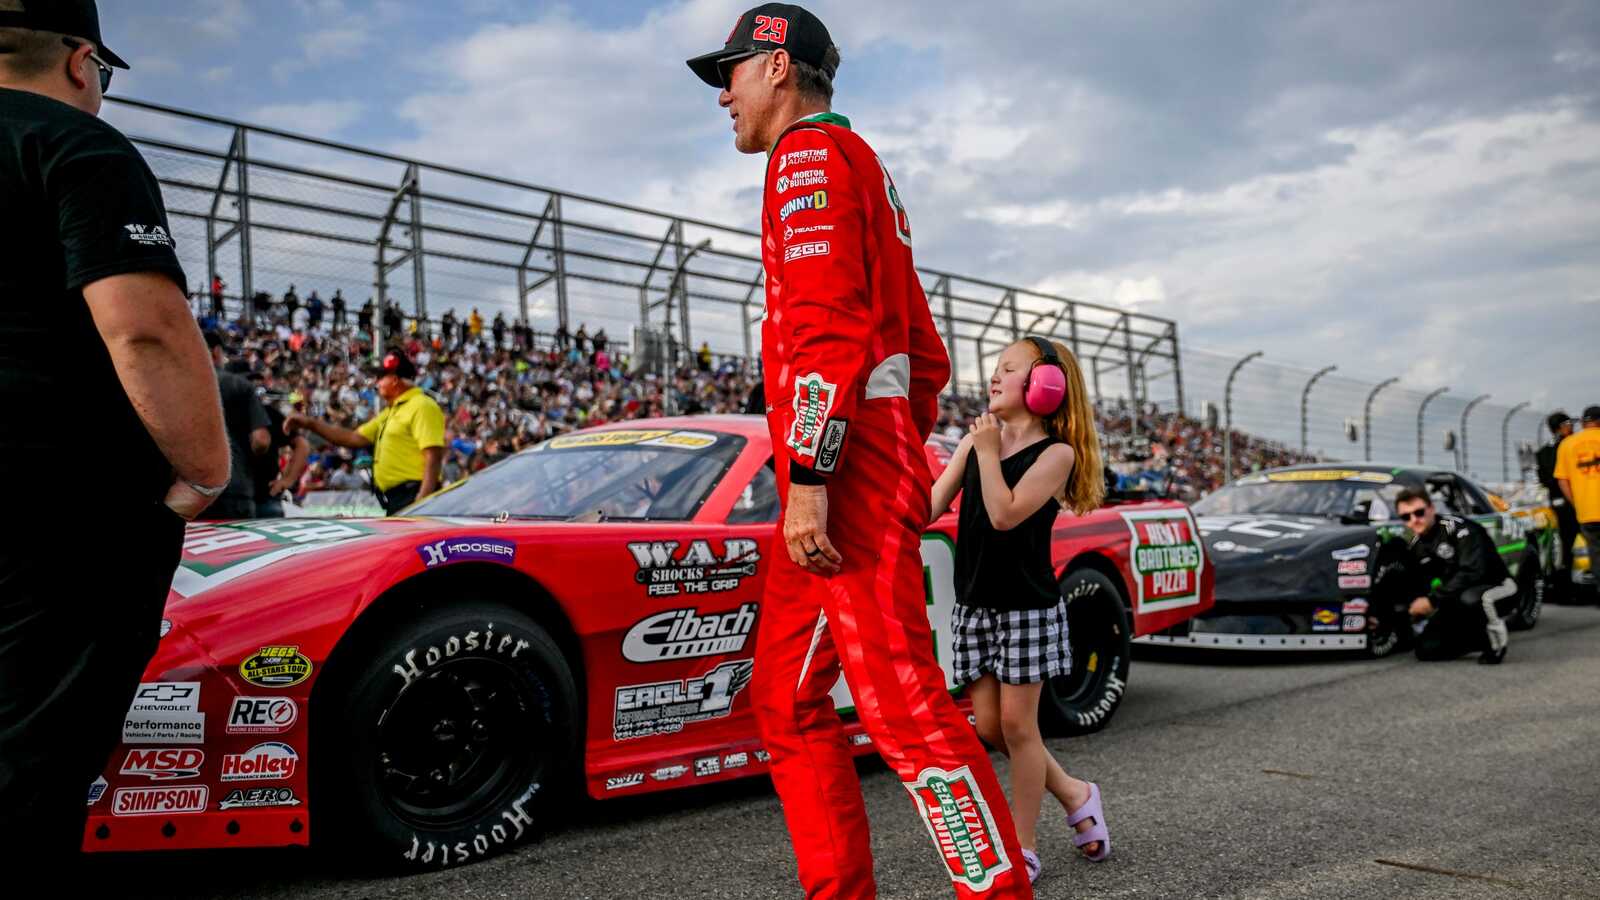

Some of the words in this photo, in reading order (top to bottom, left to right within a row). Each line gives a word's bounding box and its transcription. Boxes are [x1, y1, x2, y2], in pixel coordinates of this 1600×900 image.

[753, 15, 788, 44] 29
[788, 149, 828, 160] PRISTINE
[788, 155, 828, 166] AUCTION
[790, 177, 829, 188] BUILDINGS
[792, 169, 825, 180] MORTON
[448, 542, 514, 558] HOOSIER
[1137, 545, 1198, 573] BROTHERS
[651, 567, 705, 583] SHOCKS
[1152, 568, 1188, 595] PIZZA
[648, 583, 680, 596] FEEL
[684, 581, 708, 593] THE
[711, 578, 739, 591] GRIP
[622, 603, 758, 662] Eibach
[259, 646, 298, 657] JEGS
[392, 622, 530, 684] Hoosier
[616, 680, 705, 711] EAGLE
[700, 664, 740, 712] 1
[125, 720, 202, 730] Performance
[123, 750, 202, 770] MSD
[223, 754, 294, 778] Holley
[119, 790, 202, 811] SIMPSON
[931, 780, 983, 879] BROTHERS
[955, 795, 990, 853] PIZZA
